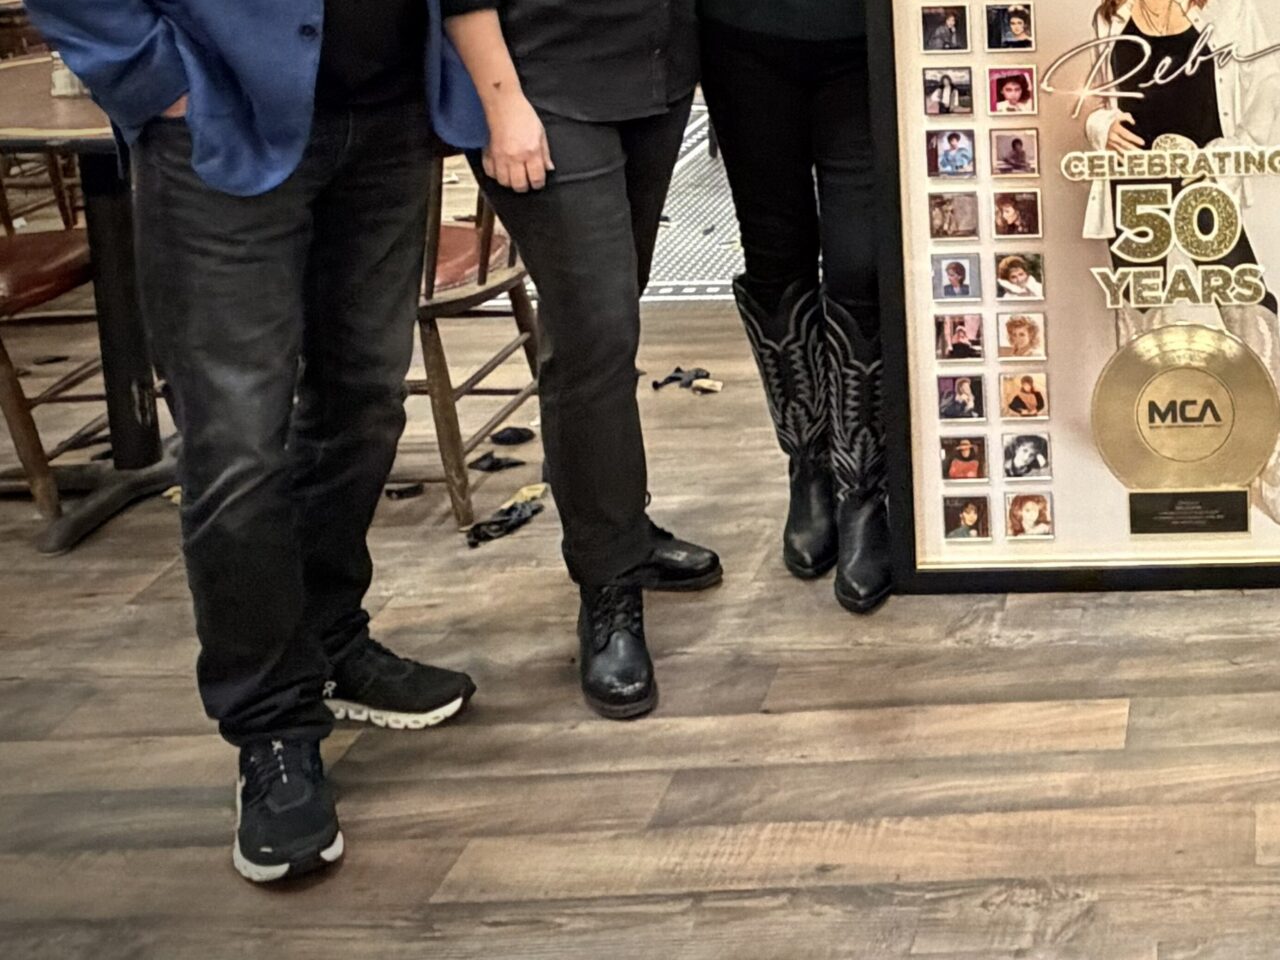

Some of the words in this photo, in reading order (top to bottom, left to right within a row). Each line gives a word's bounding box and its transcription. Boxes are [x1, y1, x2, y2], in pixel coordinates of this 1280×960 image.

[1111, 182, 1242, 263] 50
[1091, 264, 1266, 308] YEARS
[1148, 399, 1222, 423] MCA
